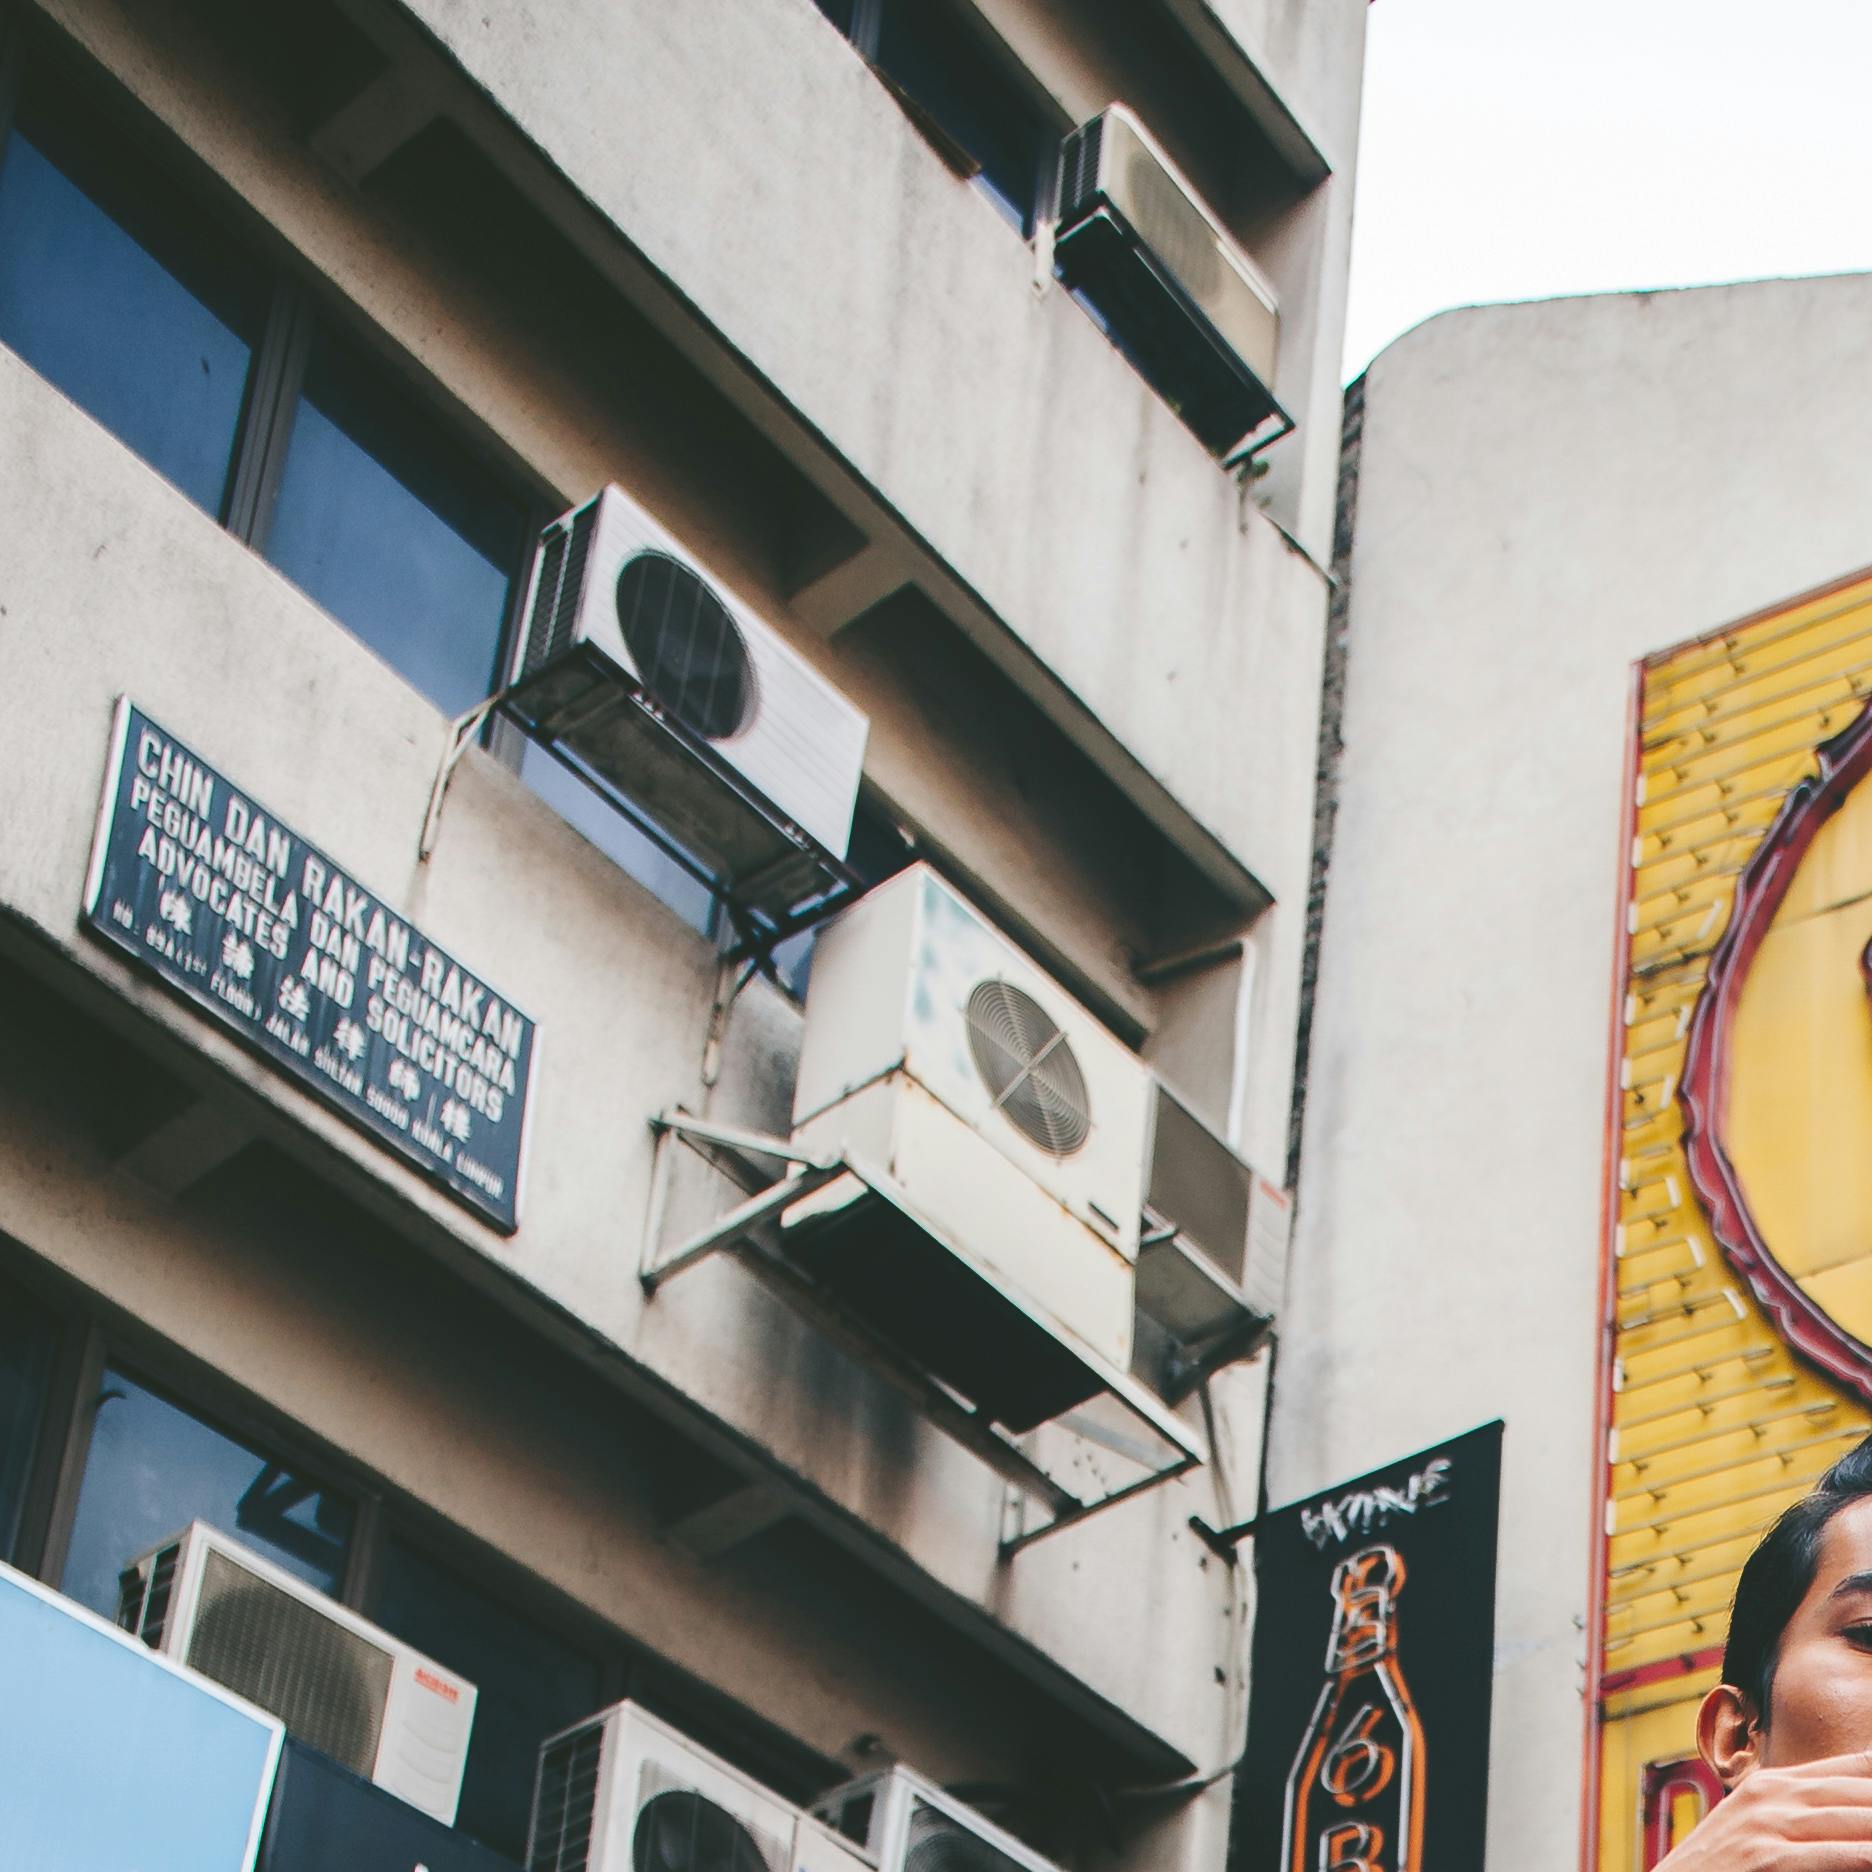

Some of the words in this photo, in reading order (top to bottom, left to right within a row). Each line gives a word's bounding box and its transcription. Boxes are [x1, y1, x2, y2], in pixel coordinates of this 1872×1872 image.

[130, 777, 298, 930] PEGUAMBELA
[308, 910, 359, 976] DAN
[367, 955, 516, 1097] PEGUAMCARA
[137, 728, 213, 821] CHIN
[224, 795, 291, 879] DAN
[300, 855, 524, 1060] RAKAN-RAKAN
[137, 825, 289, 961] ADVOCATES
[300, 946, 356, 1009] AND
[366, 992, 504, 1124] SOLICITORS
